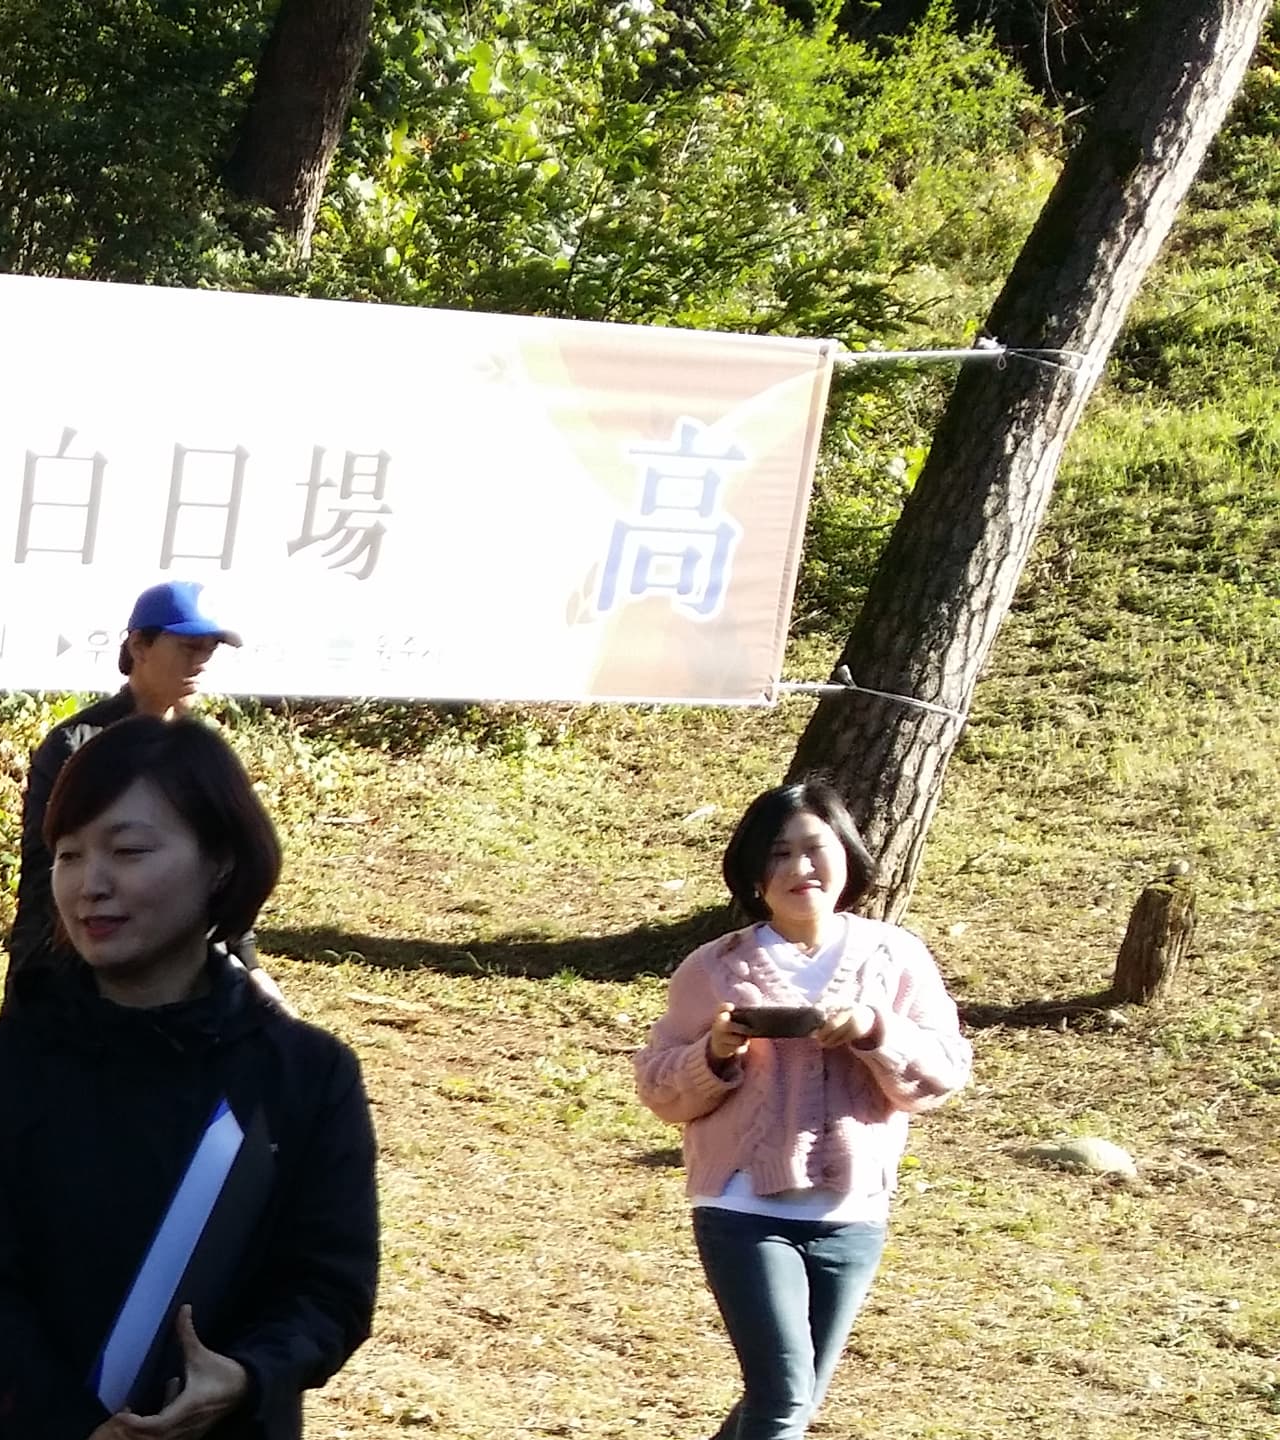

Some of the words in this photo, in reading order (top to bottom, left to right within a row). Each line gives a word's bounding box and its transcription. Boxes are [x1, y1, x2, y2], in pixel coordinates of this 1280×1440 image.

[14, 426, 394, 582] 白日場
[596, 422, 747, 616] 高
